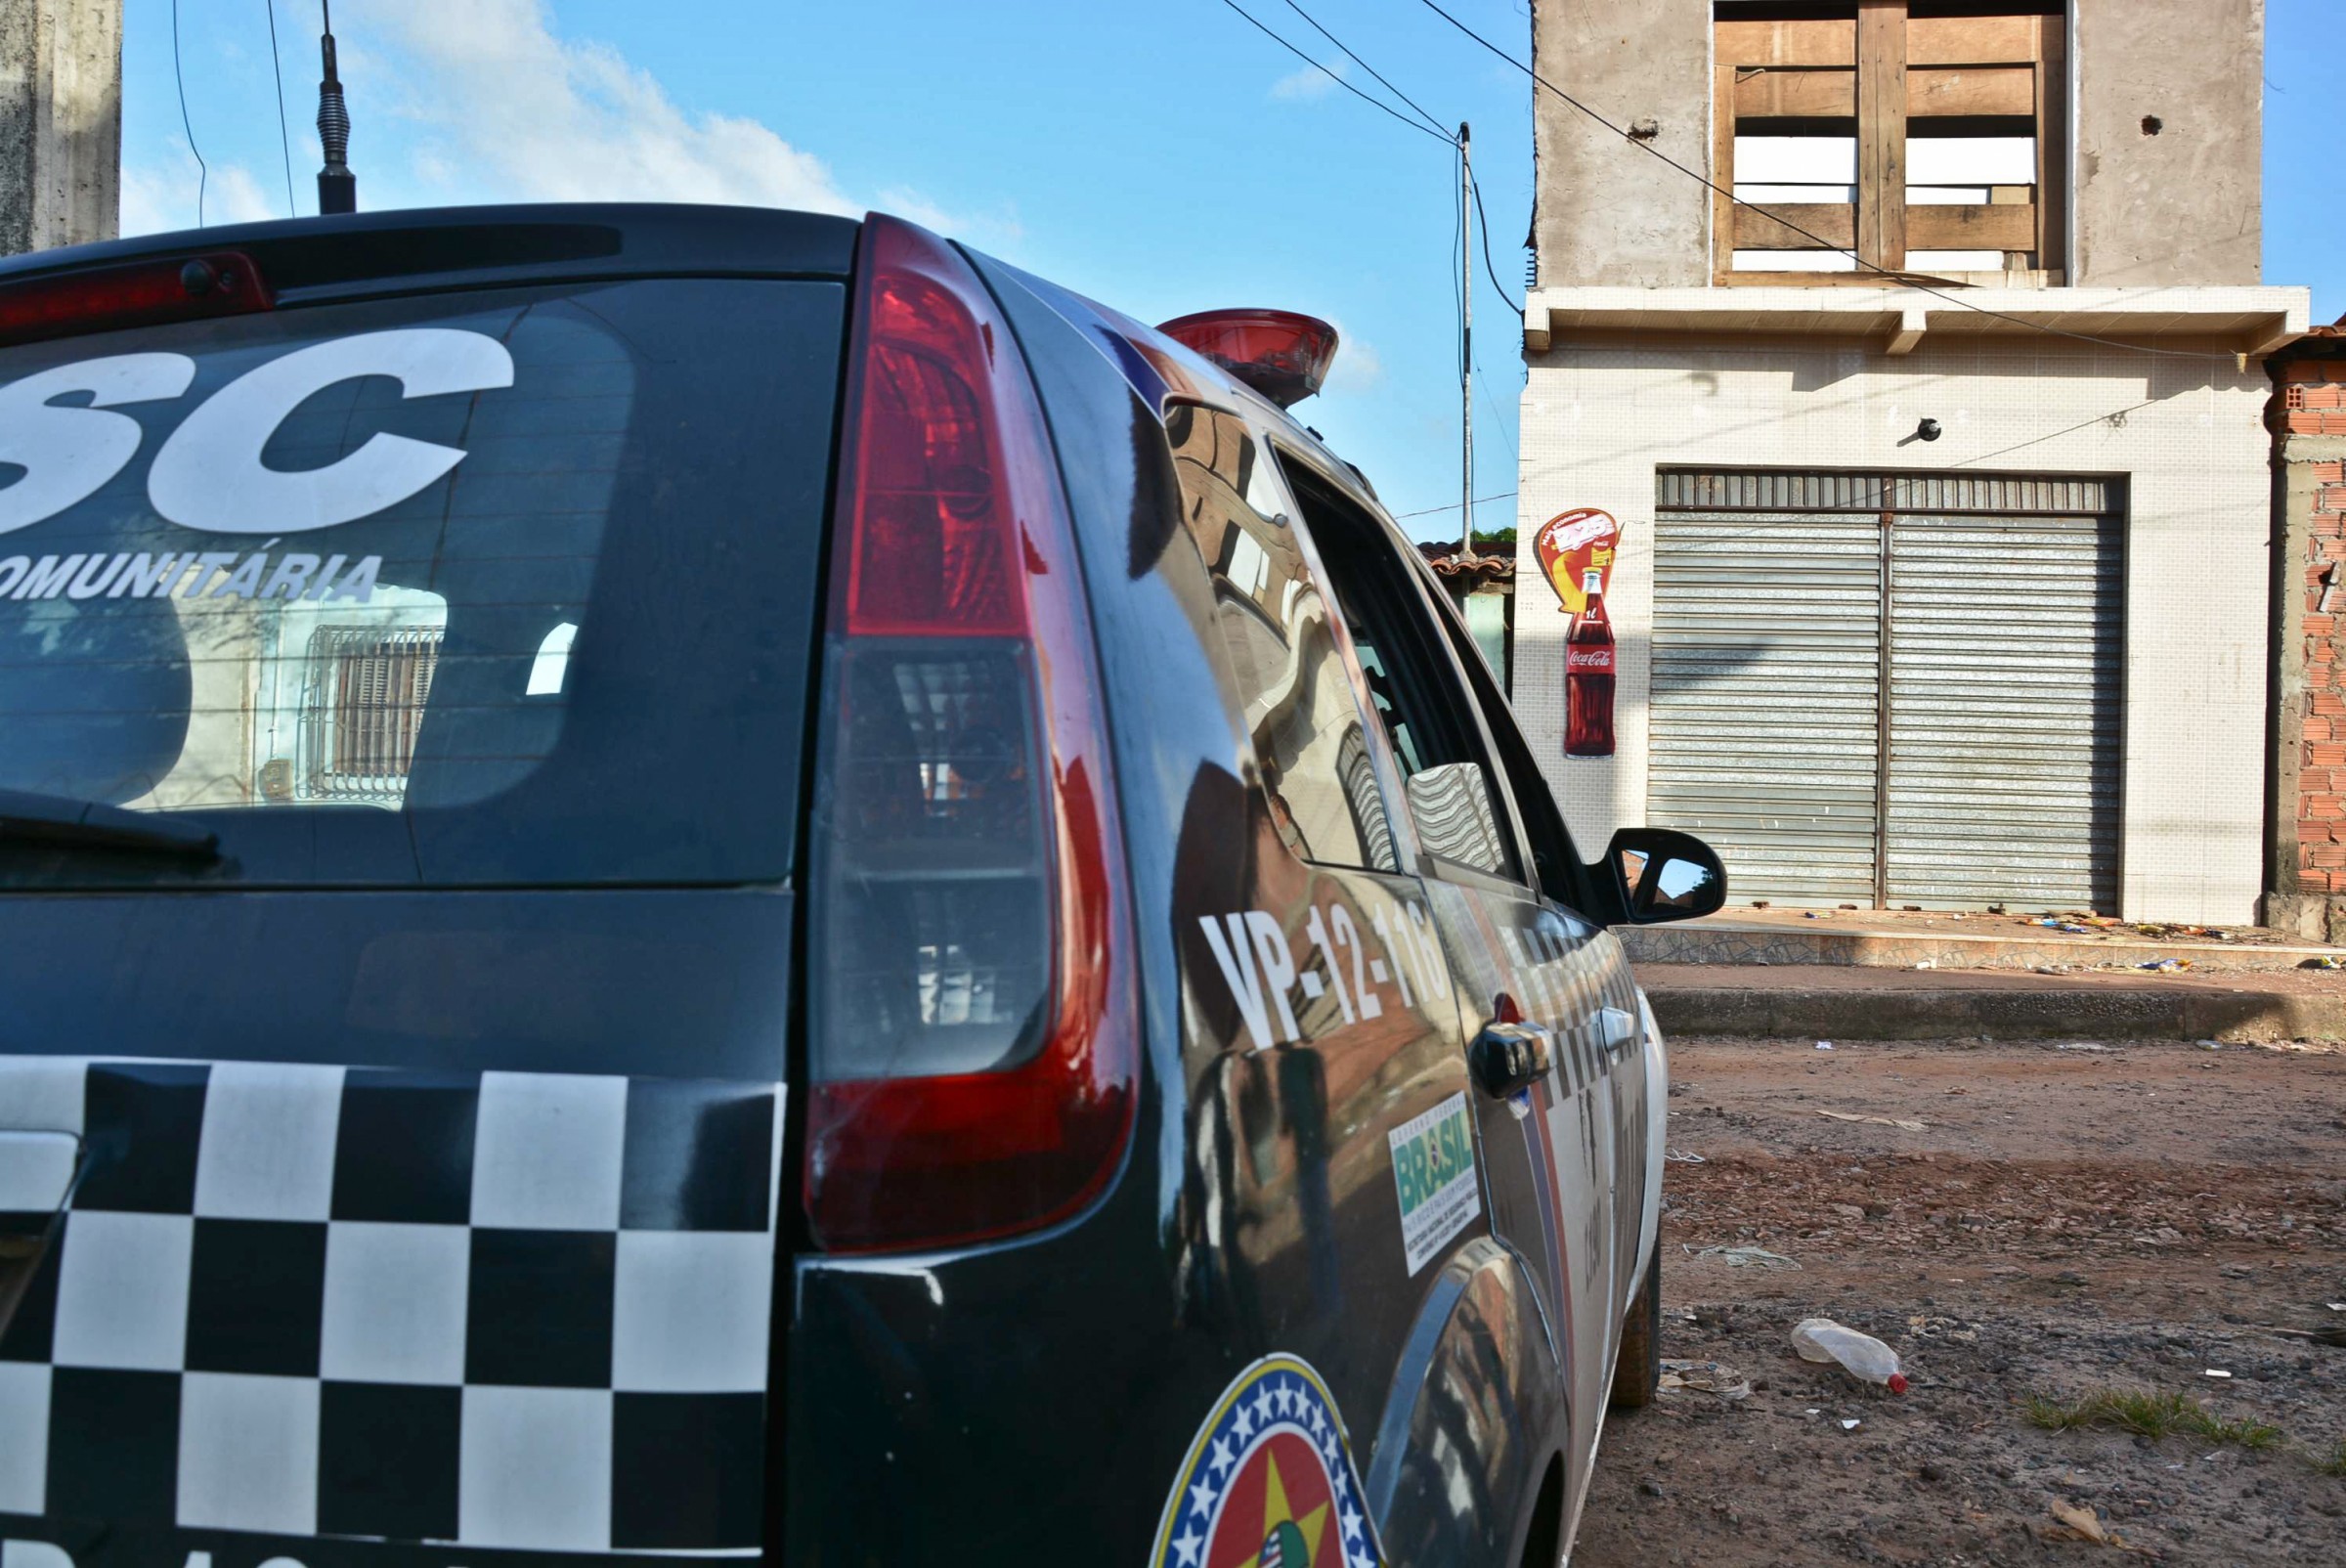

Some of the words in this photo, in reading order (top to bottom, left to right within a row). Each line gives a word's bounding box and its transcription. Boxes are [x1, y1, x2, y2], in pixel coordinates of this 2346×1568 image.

[1552, 512, 1586, 530] economia
[1198, 899, 1447, 1051] VP-12-116
[1394, 1109, 1473, 1217] BRASIL
